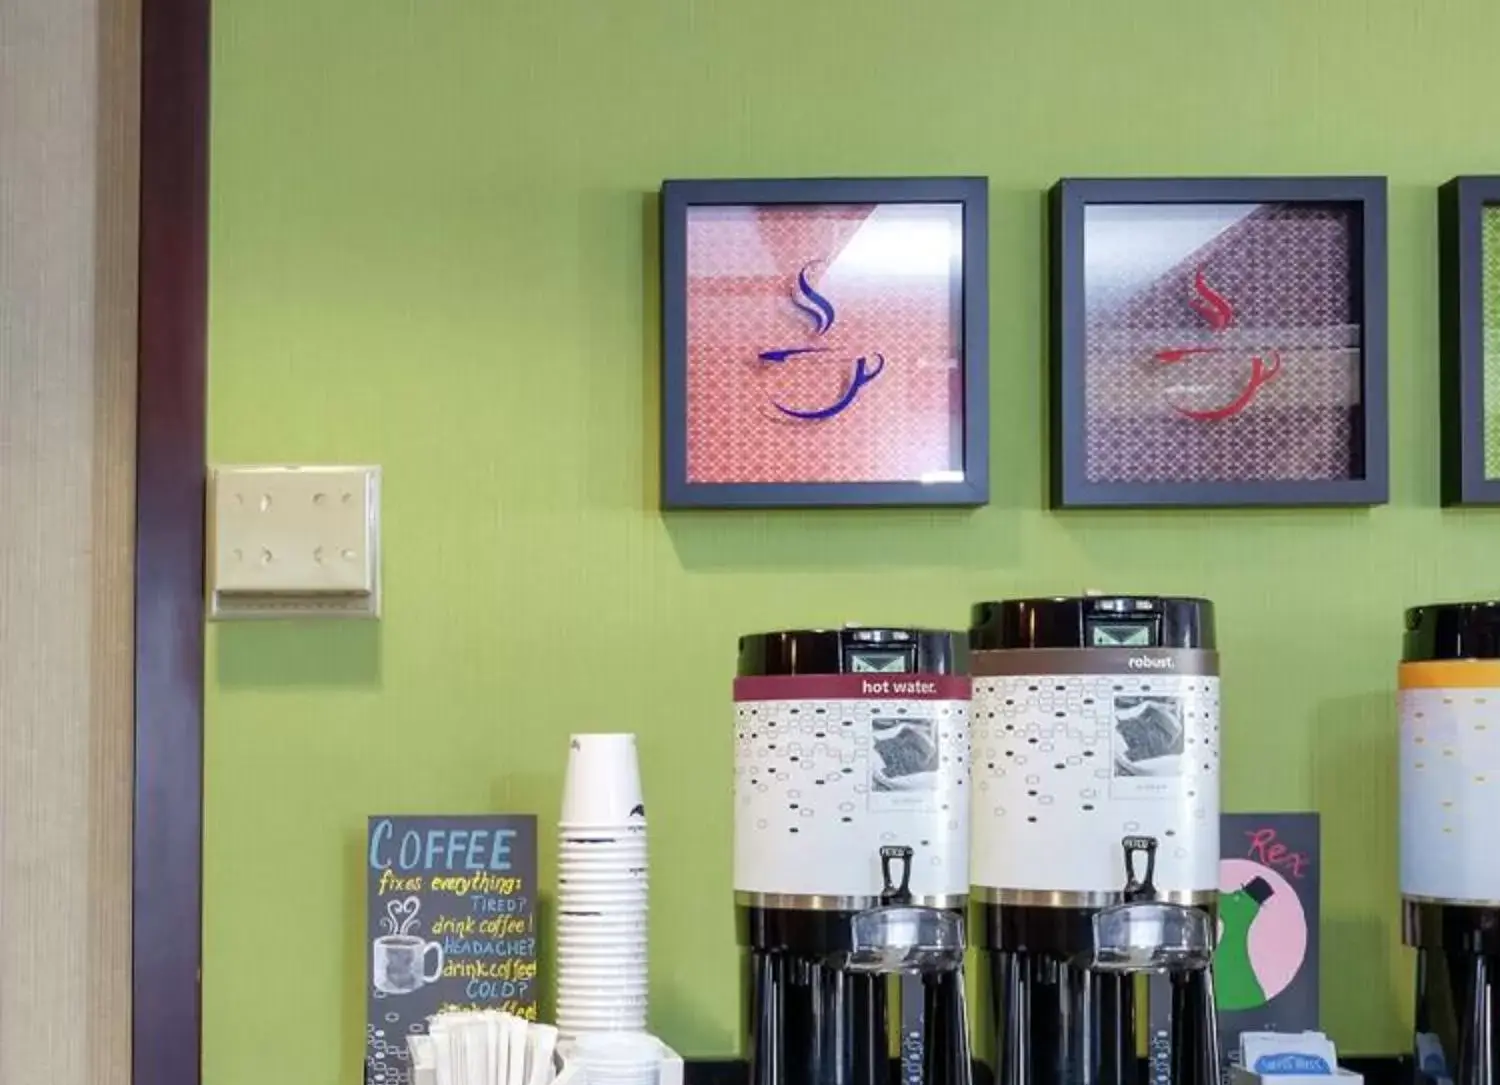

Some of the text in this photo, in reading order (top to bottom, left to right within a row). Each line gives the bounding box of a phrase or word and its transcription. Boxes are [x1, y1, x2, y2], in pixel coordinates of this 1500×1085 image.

[862, 680, 937, 693] hot water.
[370, 819, 517, 870] COFFEE
[1245, 828, 1310, 878] Rex
[378, 869, 422, 896] fixes
[470, 895, 527, 913] TIRED?
[431, 914, 476, 938] drink
[443, 936, 535, 957] HEADACHE?
[443, 960, 488, 980] drink
[465, 979, 529, 999] COLD?
